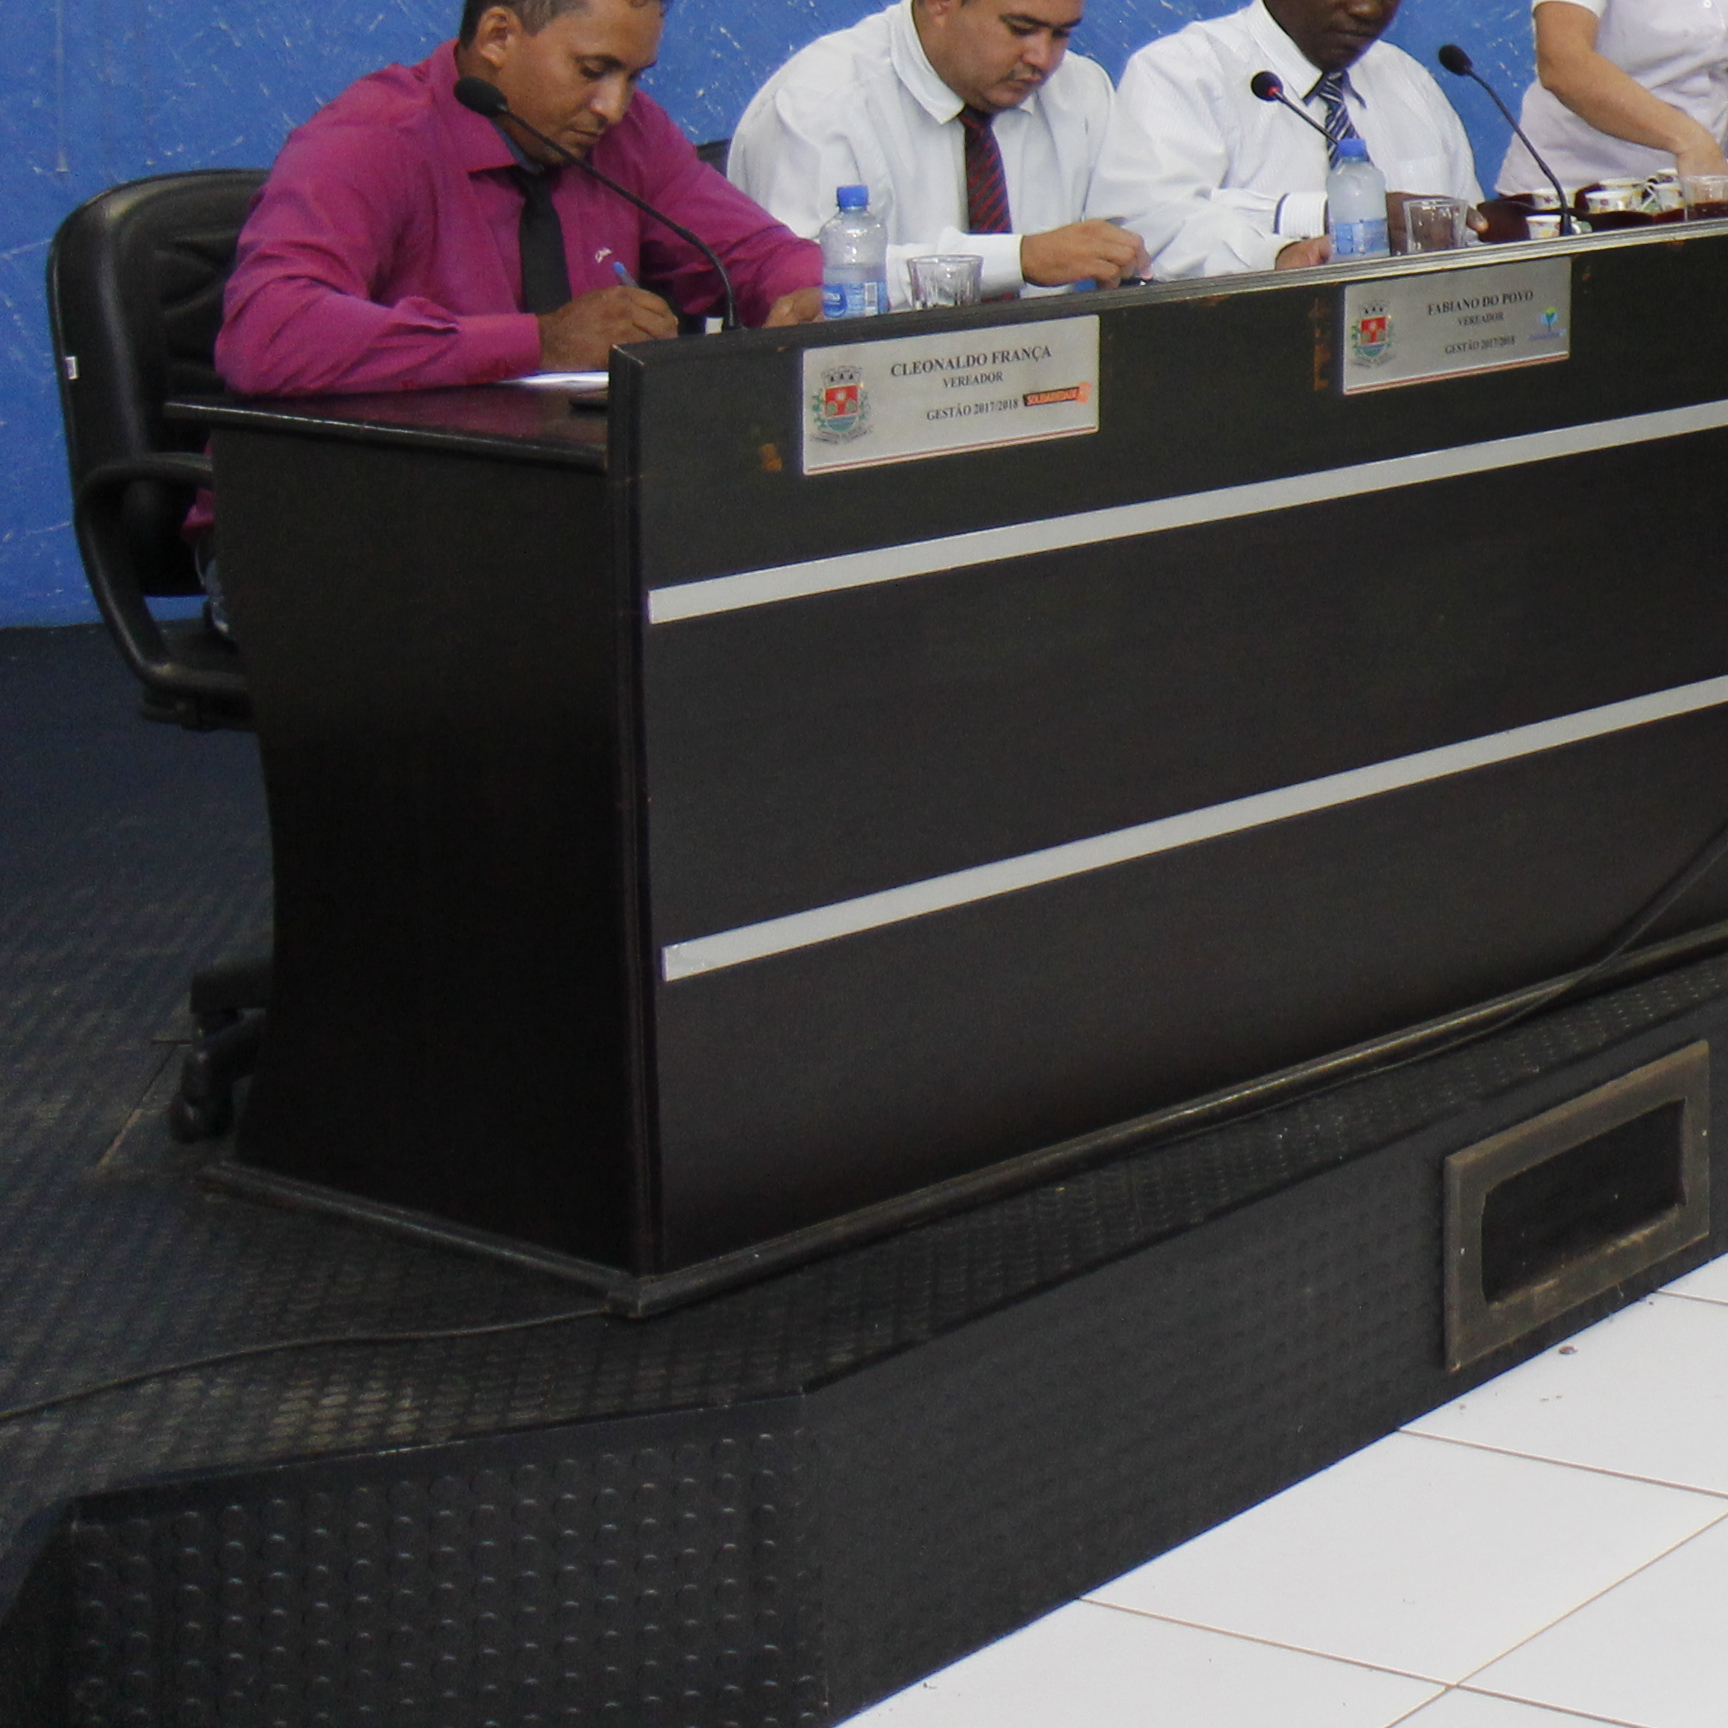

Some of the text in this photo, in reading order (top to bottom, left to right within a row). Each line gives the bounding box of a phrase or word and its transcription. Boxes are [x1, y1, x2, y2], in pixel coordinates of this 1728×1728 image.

[1427, 290, 1535, 316] FABIANO DO POVO
[1457, 312, 1505, 327] VEREADOR
[1445, 337, 1480, 355] GESTÃO
[889, 344, 1054, 378] CLEONALDO FRANÇA
[941, 371, 1005, 390] VEREADOR
[926, 398, 1020, 422] GESTÃO 2017/2018
